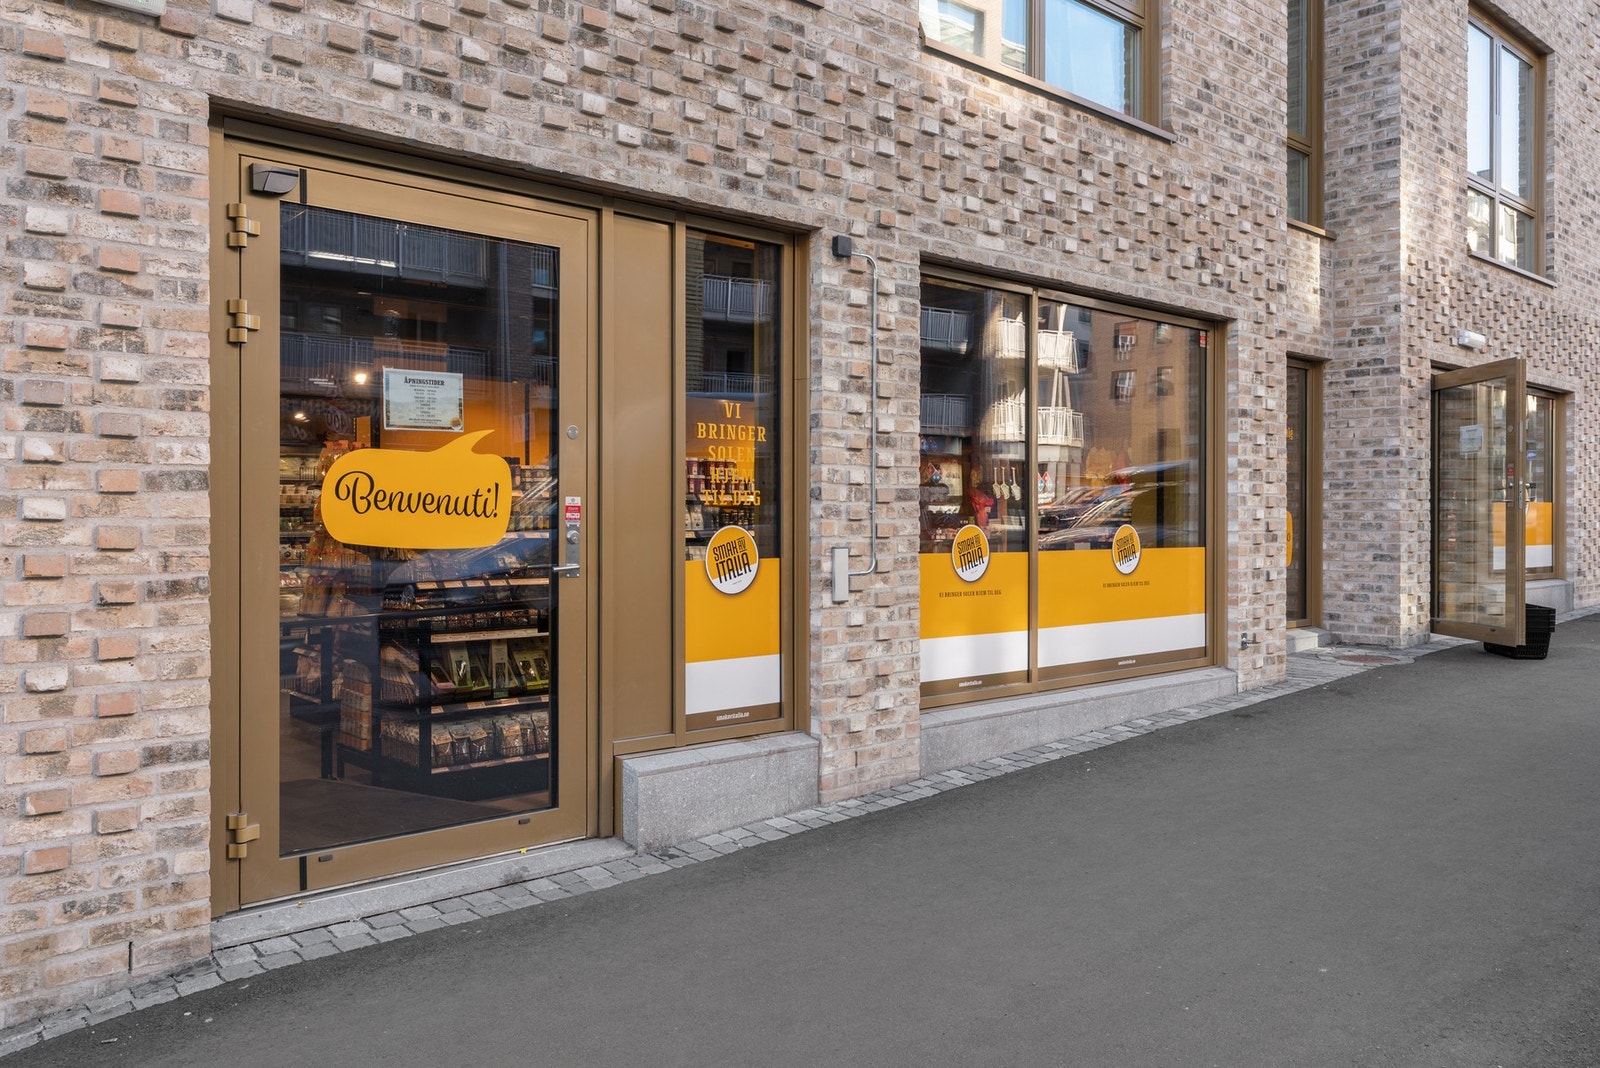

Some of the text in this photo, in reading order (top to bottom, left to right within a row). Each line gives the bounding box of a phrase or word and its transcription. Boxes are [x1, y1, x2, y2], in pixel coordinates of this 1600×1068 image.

[724, 402, 741, 419] VI
[697, 422, 766, 442] BRINGER
[708, 445, 756, 463] SOLEN
[710, 467, 755, 484] HJEM
[334, 470, 500, 519] Benvenuti!
[702, 489, 761, 506] TIL DEG
[712, 540, 739, 562] SMAK
[960, 547, 984, 573] ITALIA
[1118, 543, 1137, 566] ITALIA
[716, 552, 752, 584] ITALIA
